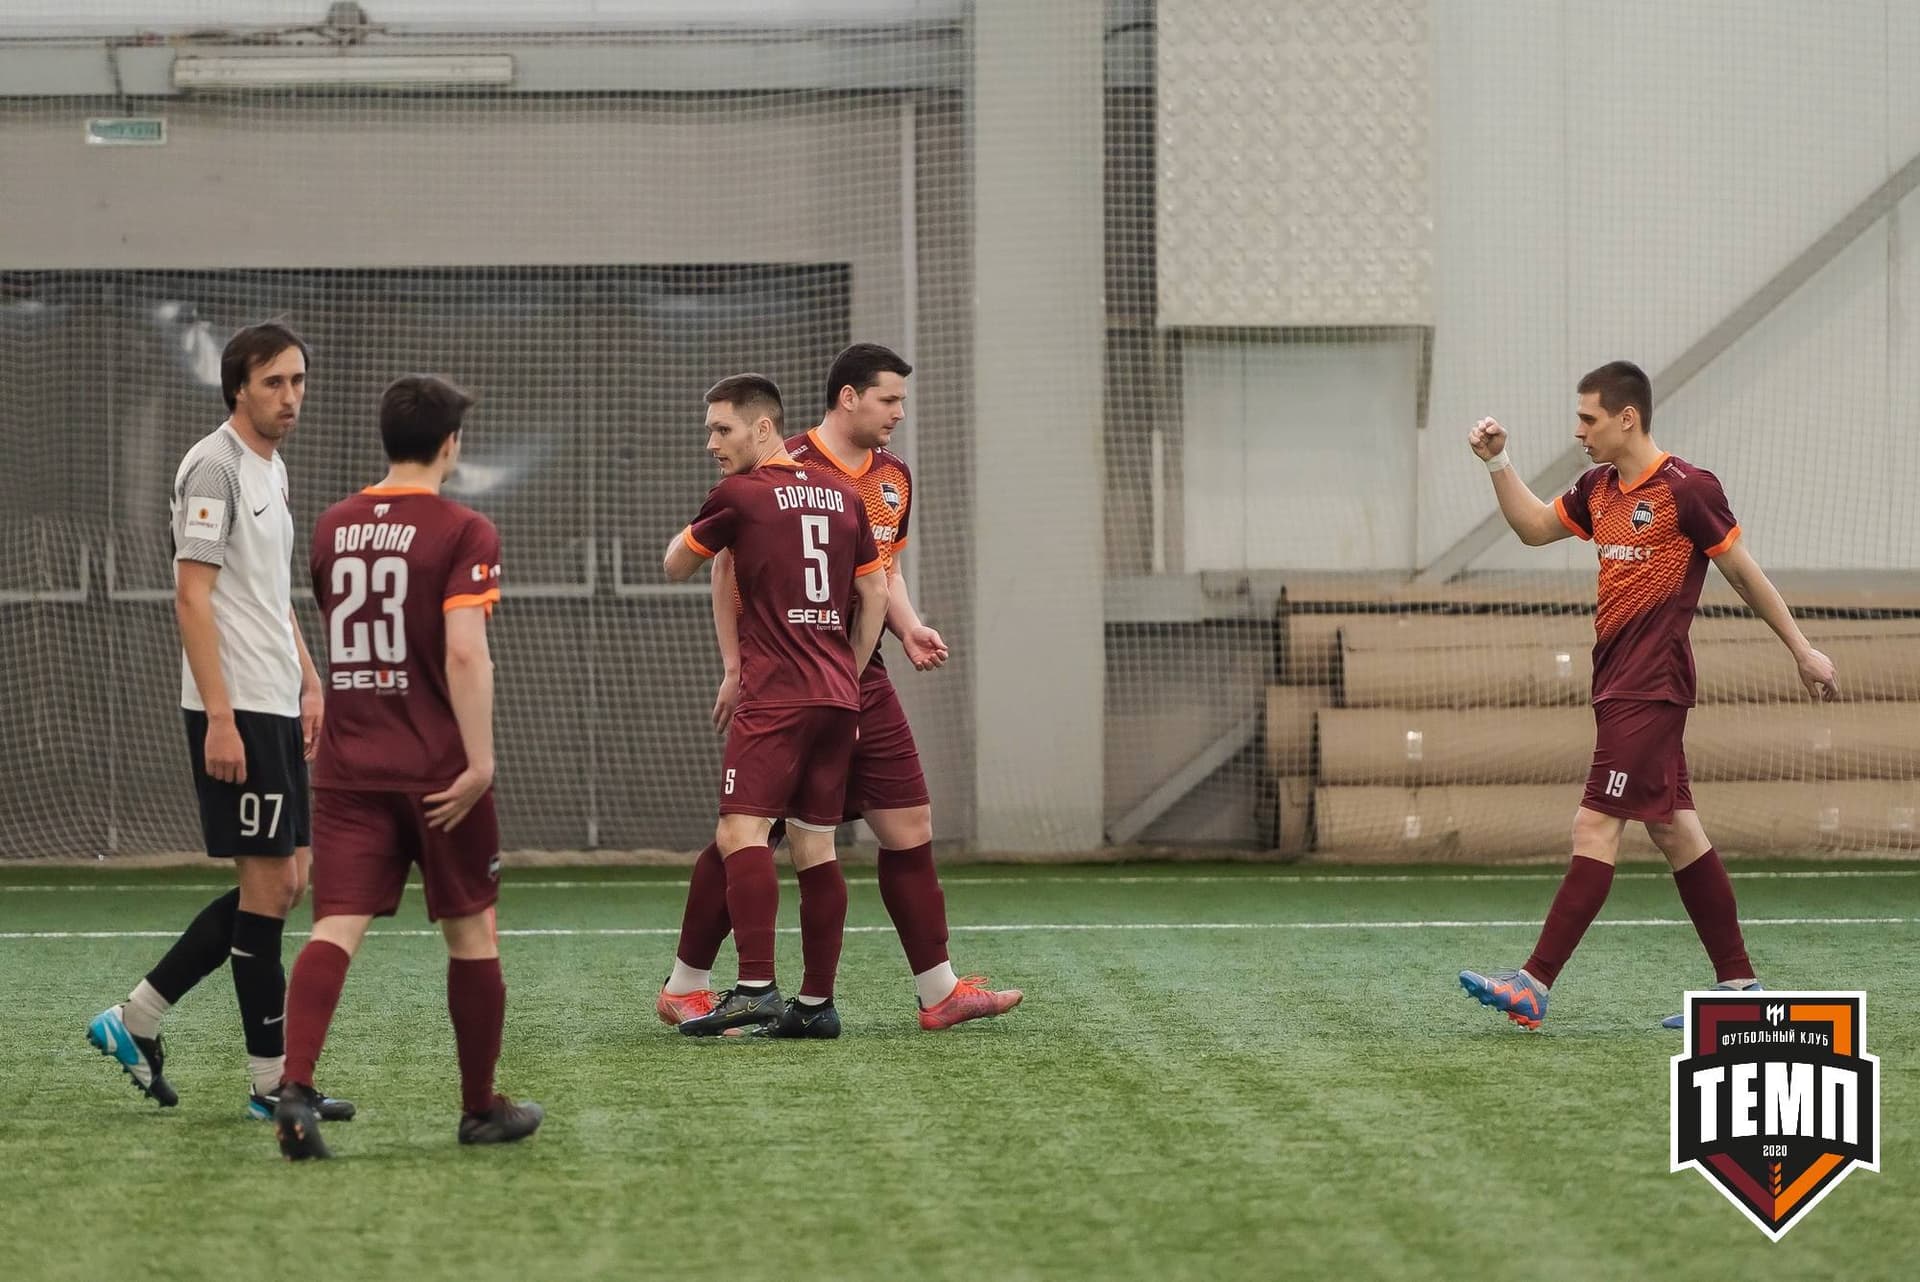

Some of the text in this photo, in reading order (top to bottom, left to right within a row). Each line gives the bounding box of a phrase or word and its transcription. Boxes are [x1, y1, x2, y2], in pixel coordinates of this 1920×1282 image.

[774, 486, 844, 513] БОРИСОВ
[334, 523, 416, 553] ВОРОНА
[801, 514, 830, 603] 5
[331, 556, 409, 665] 23
[787, 608, 840, 624] SEUS
[331, 669, 409, 690] SEUS
[1605, 769, 1629, 798] 19
[239, 792, 283, 839] 97
